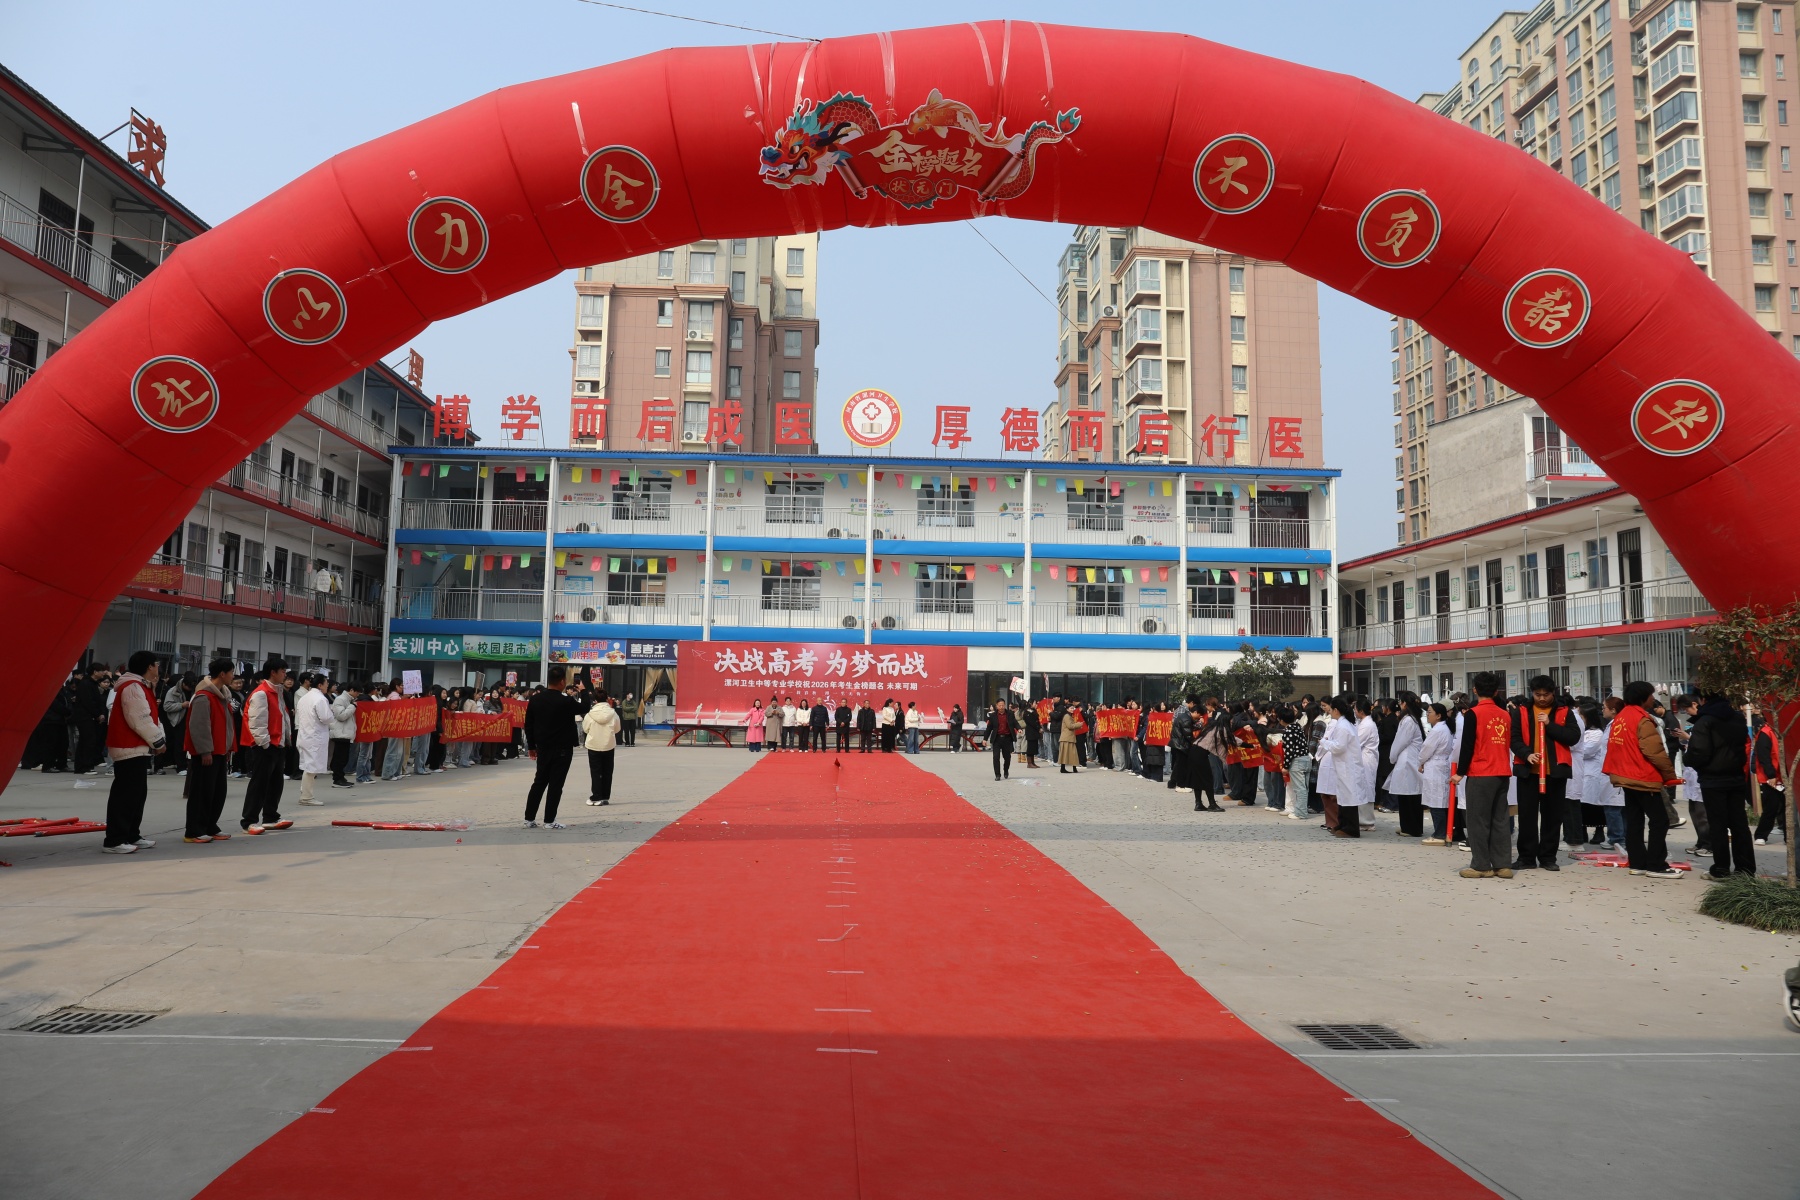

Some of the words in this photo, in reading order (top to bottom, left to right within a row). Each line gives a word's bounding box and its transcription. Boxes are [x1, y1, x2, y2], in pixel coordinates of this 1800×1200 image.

[127, 114, 167, 188] 求
[858, 129, 982, 177] 金榜题名
[892, 180, 954, 195] 状元门
[431, 394, 813, 447] 博学而后成医
[932, 404, 1304, 460] 厚德而后行医
[392, 637, 460, 655] 实训中心
[477, 642, 527, 655] 校园超市
[714, 647, 819, 678] 决战高考
[825, 649, 928, 679] 为梦而战
[886, 681, 918, 691] 未来可期
